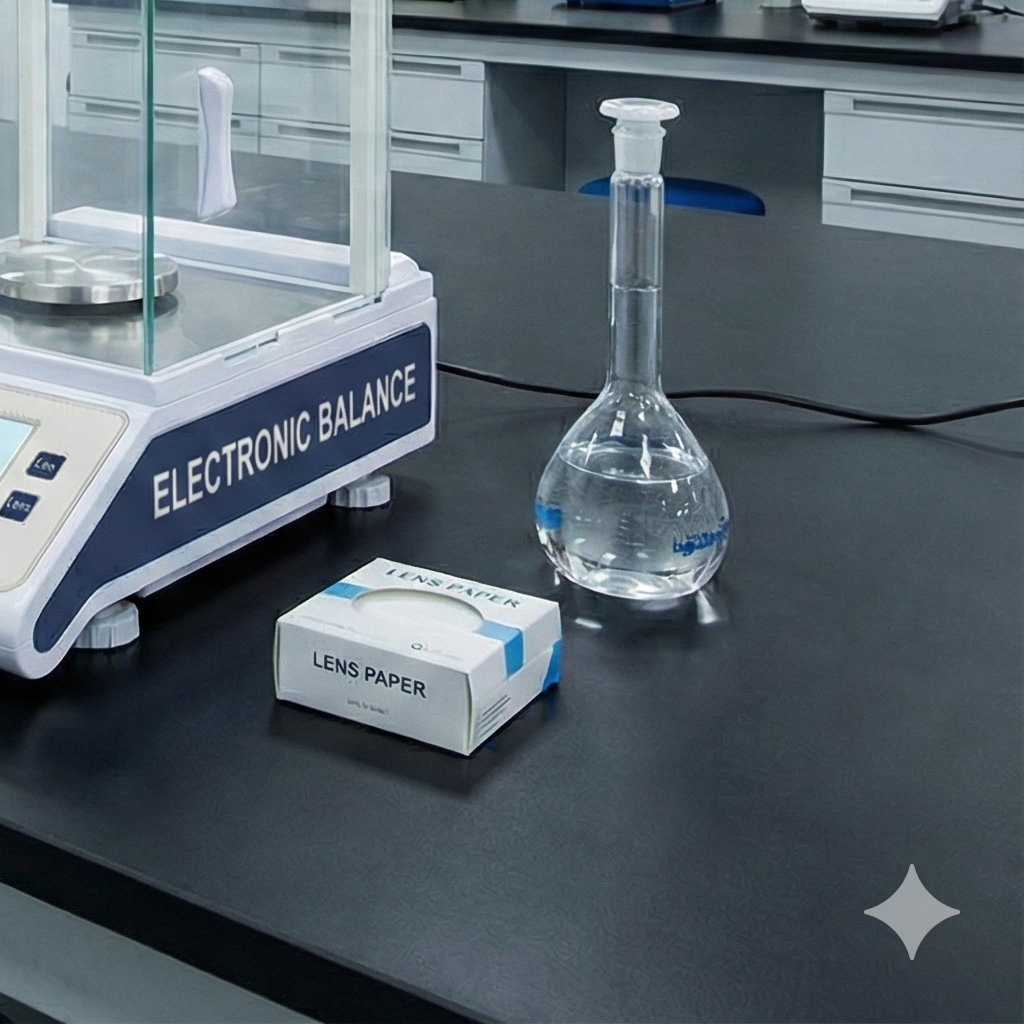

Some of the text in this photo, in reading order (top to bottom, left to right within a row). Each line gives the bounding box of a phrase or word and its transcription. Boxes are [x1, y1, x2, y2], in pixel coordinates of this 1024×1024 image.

[153, 363, 417, 520] ELECTRONIC BALANCE
[386, 568, 521, 608] LENS PAPER
[313, 651, 427, 699] LENS PAPER
